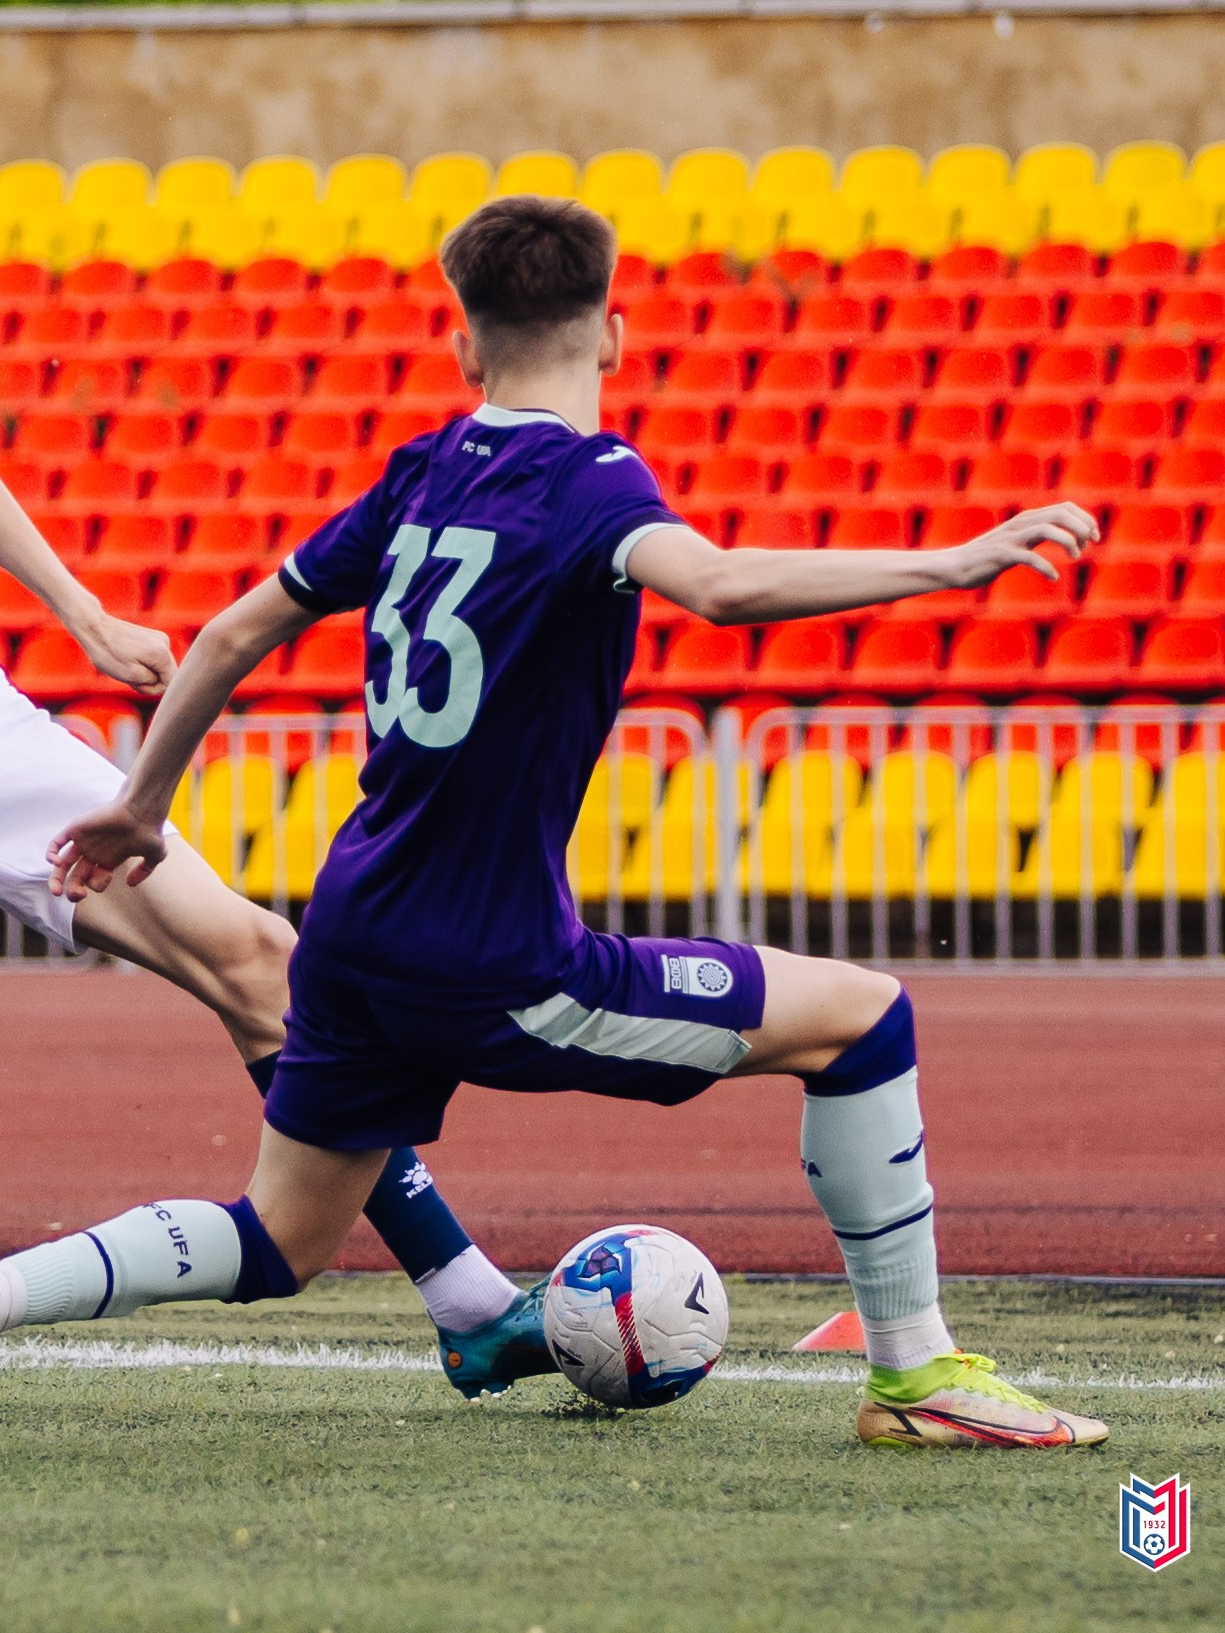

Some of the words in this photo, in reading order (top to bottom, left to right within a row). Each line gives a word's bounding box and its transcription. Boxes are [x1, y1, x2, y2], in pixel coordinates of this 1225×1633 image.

[364, 523, 497, 748] 33
[406, 1181, 432, 1199] KEL
[168, 1226, 192, 1278] UFA
